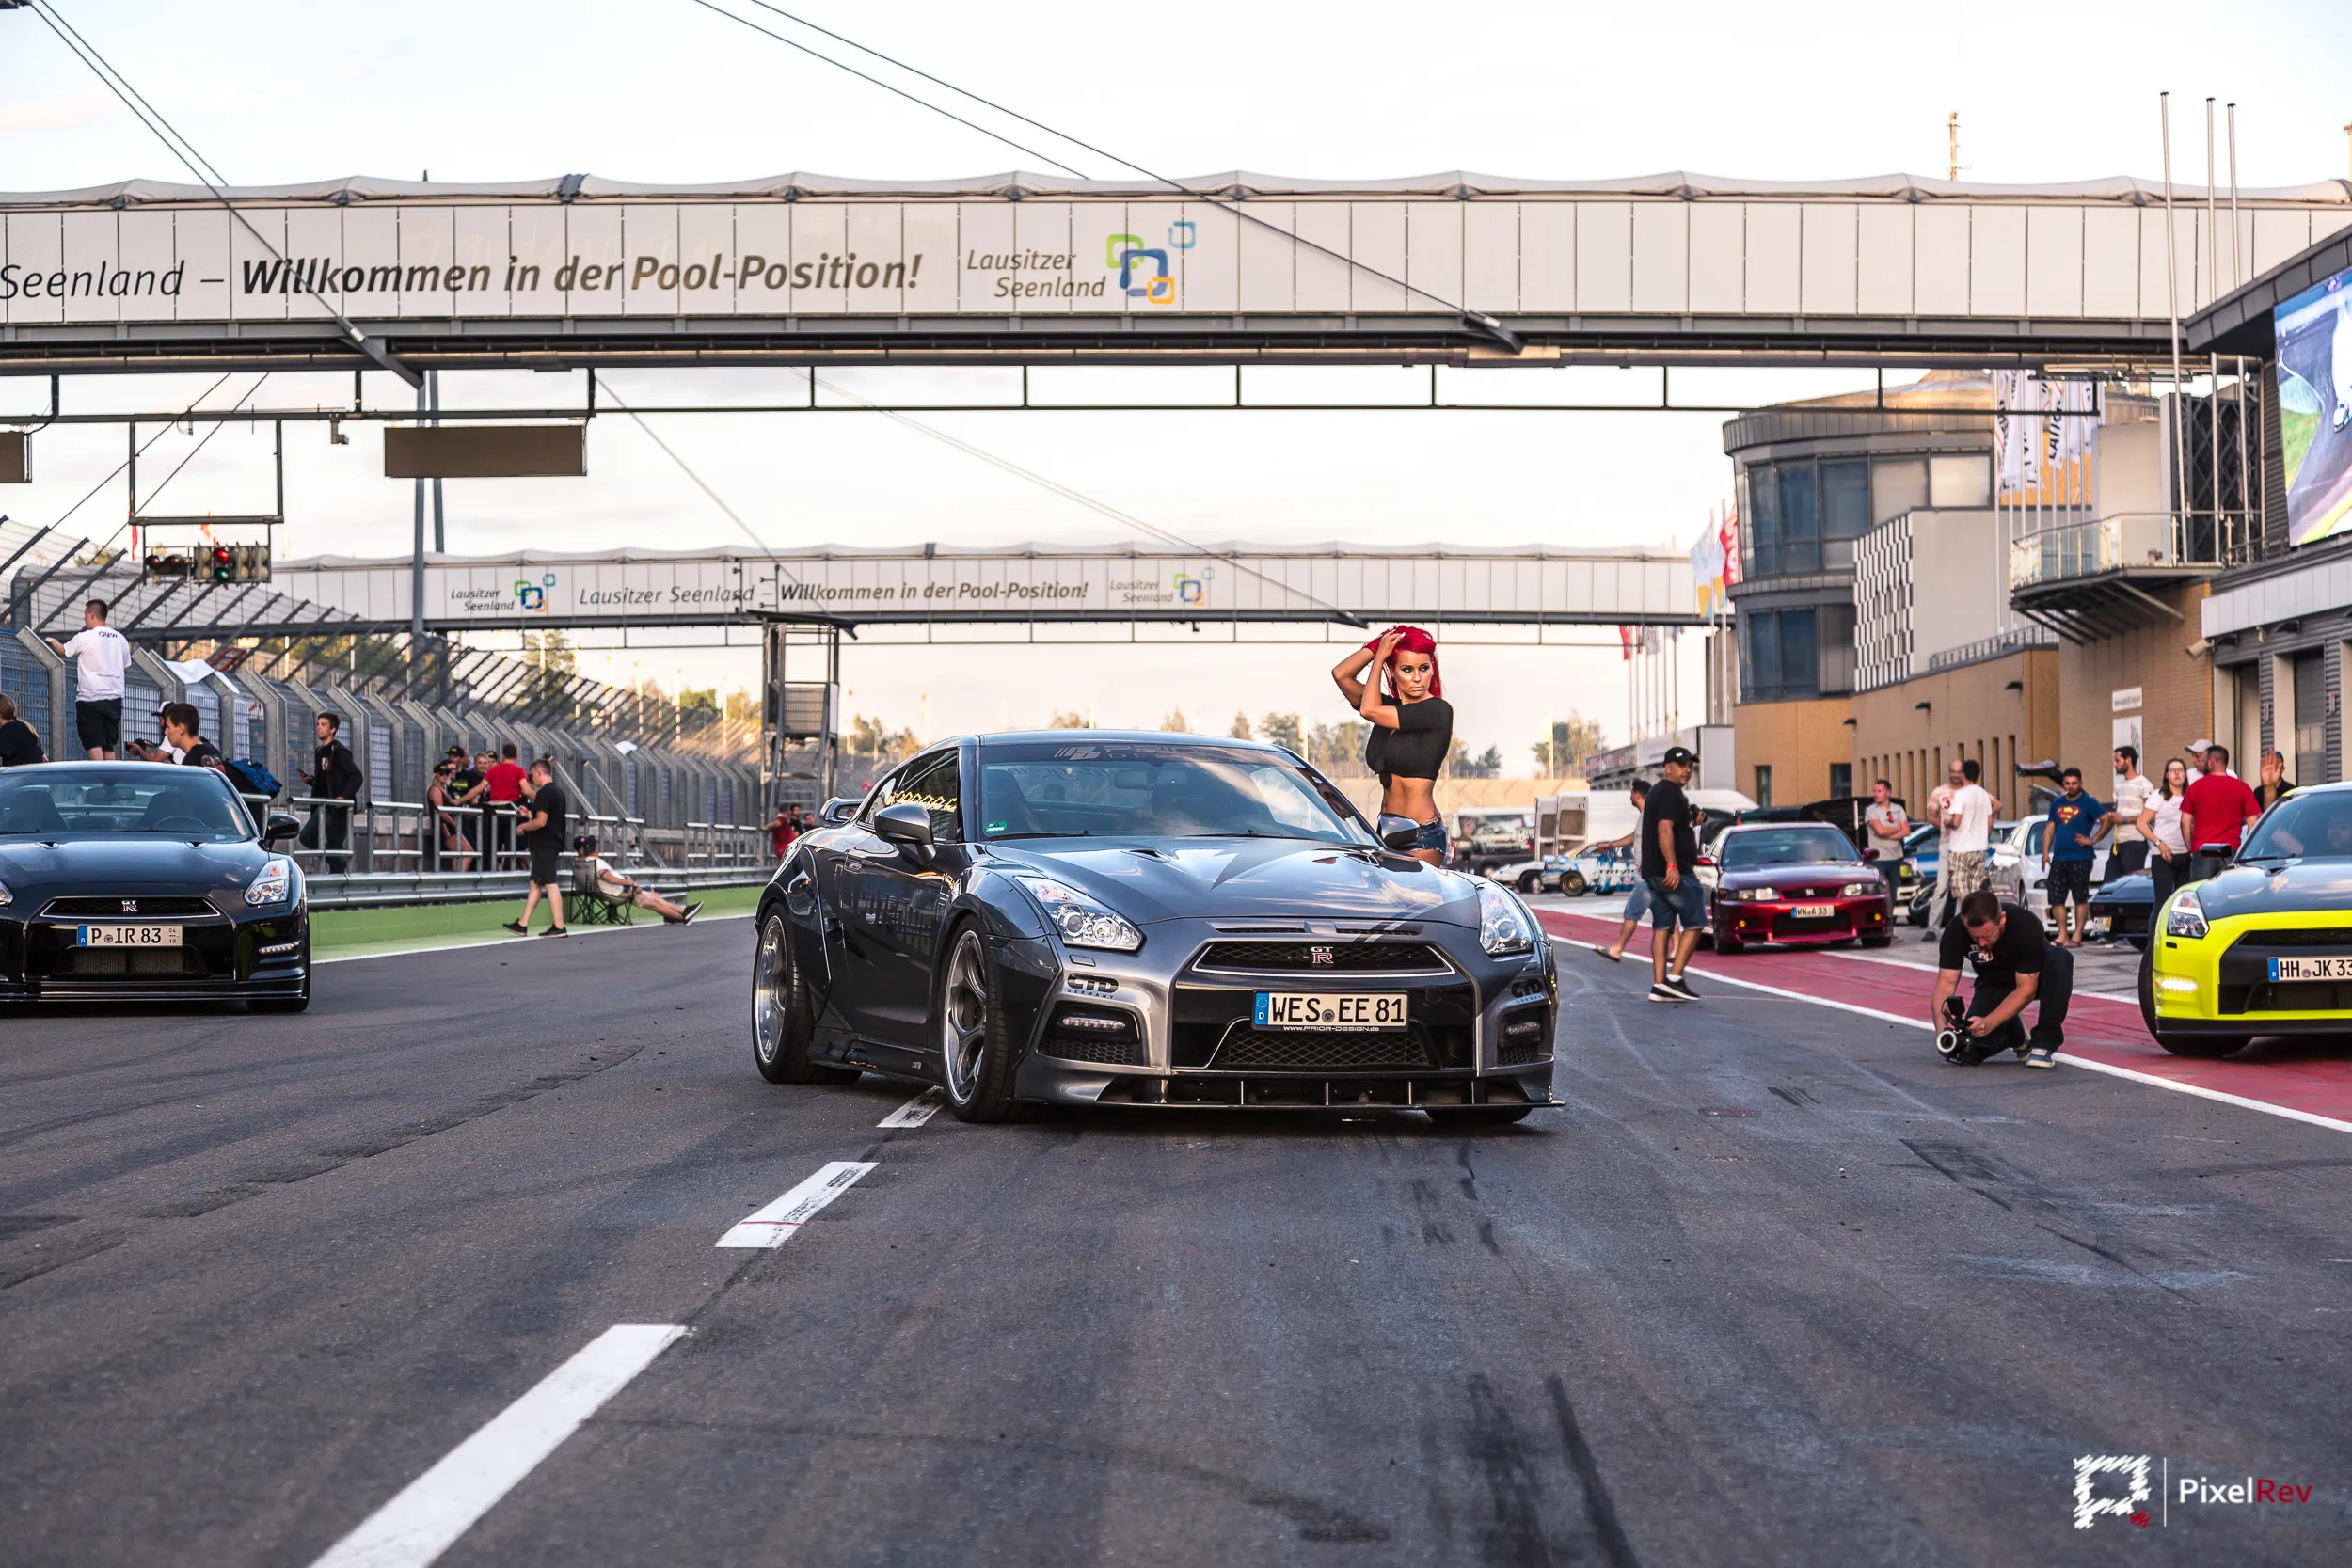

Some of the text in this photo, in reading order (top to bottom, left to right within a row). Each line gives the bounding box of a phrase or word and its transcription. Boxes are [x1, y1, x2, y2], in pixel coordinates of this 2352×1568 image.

[966, 248, 1077, 270] Lausitzer
[0, 251, 923, 300] Seenland Willkommen in der Pool-Position!
[993, 275, 1106, 298] Seenland
[1109, 579, 1161, 591] Lausitzer
[451, 588, 501, 599] Lausitzer
[579, 581, 1089, 605] Lausitzer Seenland Willkommen in der Pool-Position!
[1122, 592, 1174, 603] Seenland
[463, 600, 516, 611] Seenland
[91, 928, 102, 943] P
[115, 928, 135, 943] IR
[141, 928, 161, 943] 83
[1311, 953, 1334, 964] R
[2280, 960, 2300, 977] HH
[2312, 960, 2332, 976] JK
[1067, 989, 1114, 999] GERMANY
[1258, 997, 1405, 1022] D WES EE 81
